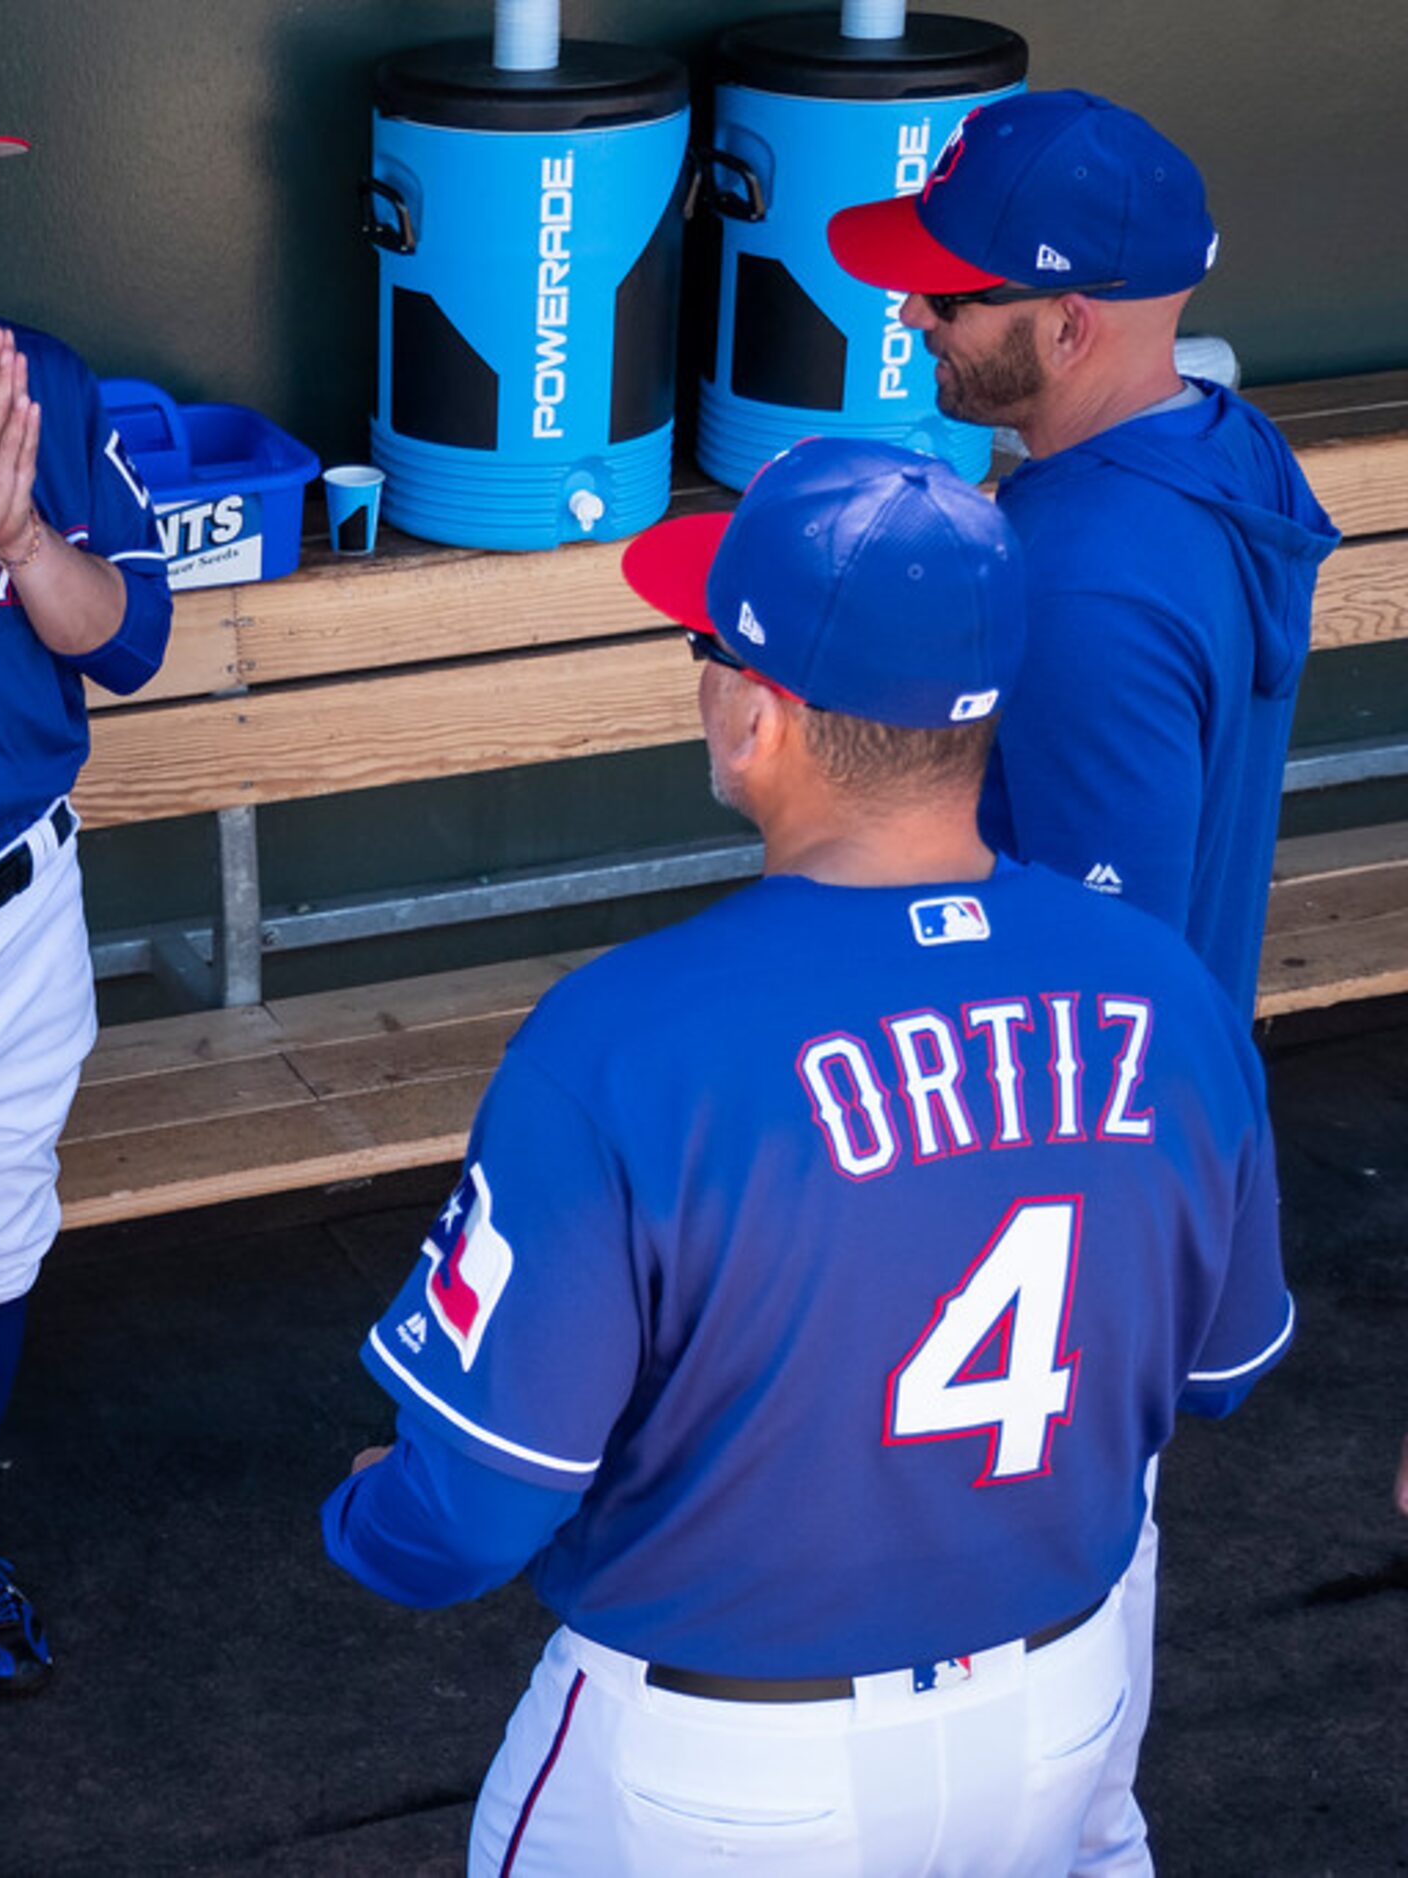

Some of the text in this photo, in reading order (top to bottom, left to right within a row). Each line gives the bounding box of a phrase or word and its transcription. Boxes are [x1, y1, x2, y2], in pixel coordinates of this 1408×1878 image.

[532, 155, 574, 439] POWERADE
[878, 123, 930, 399] POWDE
[796, 991, 1155, 1182] ORTIZ
[882, 1194, 1083, 1488] 4
